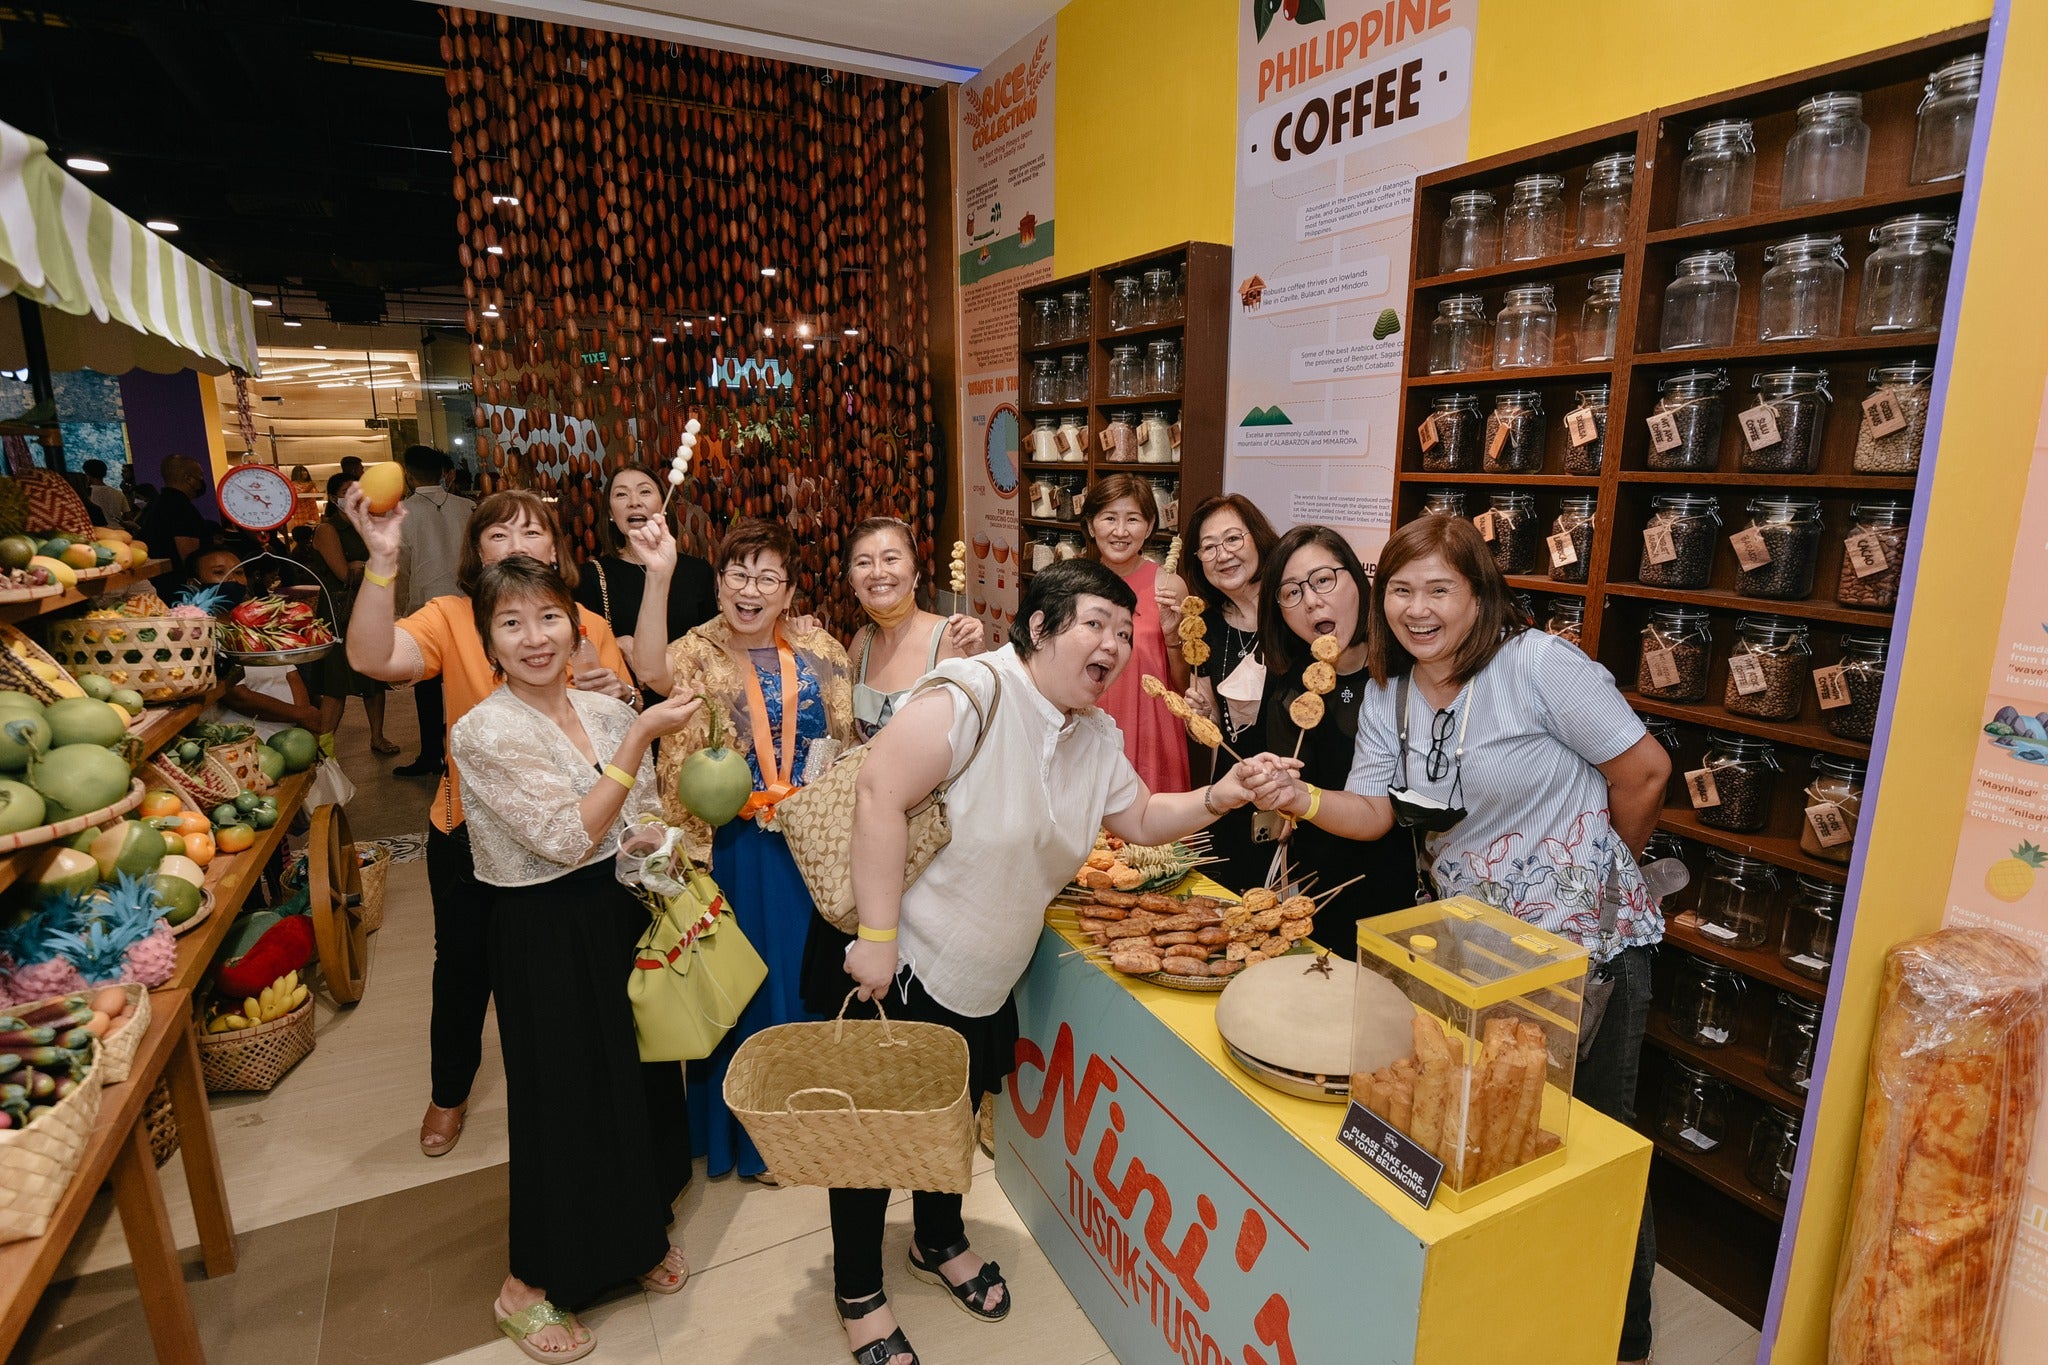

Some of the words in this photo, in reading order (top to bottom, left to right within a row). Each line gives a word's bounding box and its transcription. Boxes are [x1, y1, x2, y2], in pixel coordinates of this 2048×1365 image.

[1259, 0, 1451, 103] PHILIPPINE
[982, 63, 1025, 123] RICE
[1273, 57, 1422, 162] COFFEE
[972, 95, 1037, 151] COLLECTION
[1306, 201, 1330, 213] Abundant
[1347, 190, 1374, 202] provinces
[1382, 179, 1411, 191] Batangas,
[1322, 209, 1333, 217] and
[1334, 202, 1355, 213] Quezon,
[1357, 197, 1376, 207] barako
[1377, 191, 1396, 202] coffee
[1304, 222, 1318, 230] most
[1318, 217, 1337, 226] famous
[1339, 210, 1361, 222] variation
[1363, 207, 1369, 215] of
[1370, 200, 1393, 212] Liberica
[1264, 287, 1286, 296] Robusta
[1287, 283, 1306, 291] coffee
[1307, 278, 1327, 288] thrives
[1338, 270, 1368, 280] lowlands
[1300, 289, 1325, 299] Bulacan,
[1327, 285, 1340, 294] and
[1301, 351, 1317, 359] Some
[1350, 344, 1373, 353] Arabica
[1375, 342, 1395, 350] coffee
[1315, 358, 1343, 366] provinces
[1351, 353, 1378, 362] Benguet,
[1346, 364, 1363, 372] South
[1868, 403, 1882, 426] BEANS
[1880, 401, 1895, 421] GREEN
[1651, 423, 1664, 442] COFFEE
[1663, 430, 1673, 442] APO
[1745, 419, 1760, 442] COFFEE
[1758, 418, 1770, 435] SULU
[1858, 540, 1874, 565] CACAO
[2011, 652, 2037, 663] from
[2013, 642, 2048, 654] Manda
[1818, 677, 1831, 700] COFFEE
[2006, 674, 2019, 684] its
[1979, 768, 2014, 782] Manila
[2018, 778, 2039, 787] was
[1973, 800, 2005, 812] called
[1975, 790, 2035, 809] abundance
[1813, 813, 1831, 837] COFFEE
[1971, 809, 1988, 819] the
[1992, 814, 2024, 827] banks
[2027, 824, 2040, 832] of
[1950, 915, 1975, 928] from
[1994, 919, 2023, 932] name
[1343, 1130, 1356, 1141] OF
[1354, 1139, 1376, 1159] YOUR
[1376, 1155, 1428, 1199] BELONGINGS
[1351, 1126, 1380, 1152] PLEASE
[1380, 1147, 1401, 1167] TAKE
[1401, 1164, 1424, 1185] CARE
